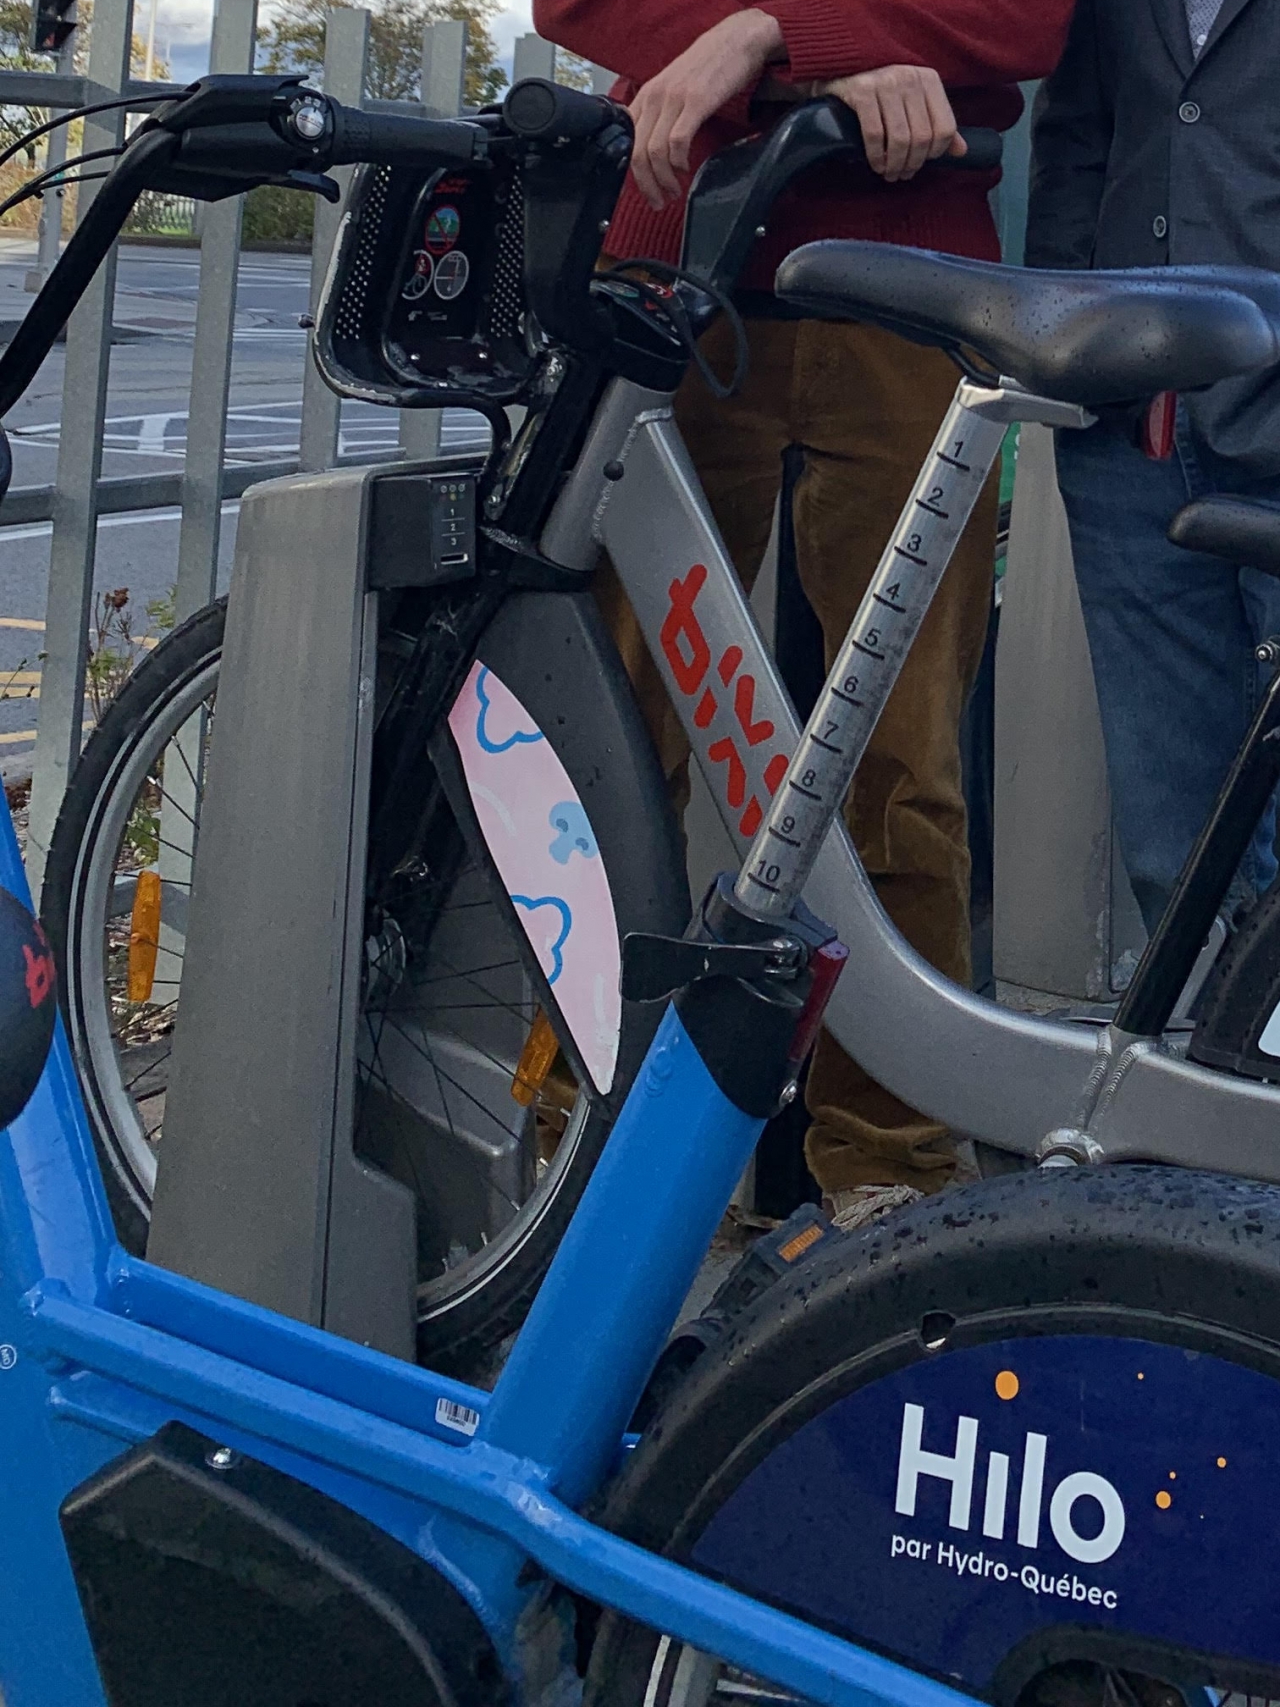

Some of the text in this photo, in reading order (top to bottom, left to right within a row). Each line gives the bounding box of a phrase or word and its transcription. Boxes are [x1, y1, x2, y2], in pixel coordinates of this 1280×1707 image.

[949, 440, 964, 458] 1
[927, 486, 943, 505] 2
[906, 535, 922, 552] 3
[886, 582, 901, 600] 4
[865, 629, 880, 646] 5
[844, 676, 859, 693] 6
[826, 721, 840, 739] 7
[802, 770, 816, 787] 8
[782, 817, 796, 834] 9
[757, 859, 782, 883] 10
[895, 1403, 1126, 1564] Hilo
[891, 1534, 1118, 1609] par Hydro-Québec
